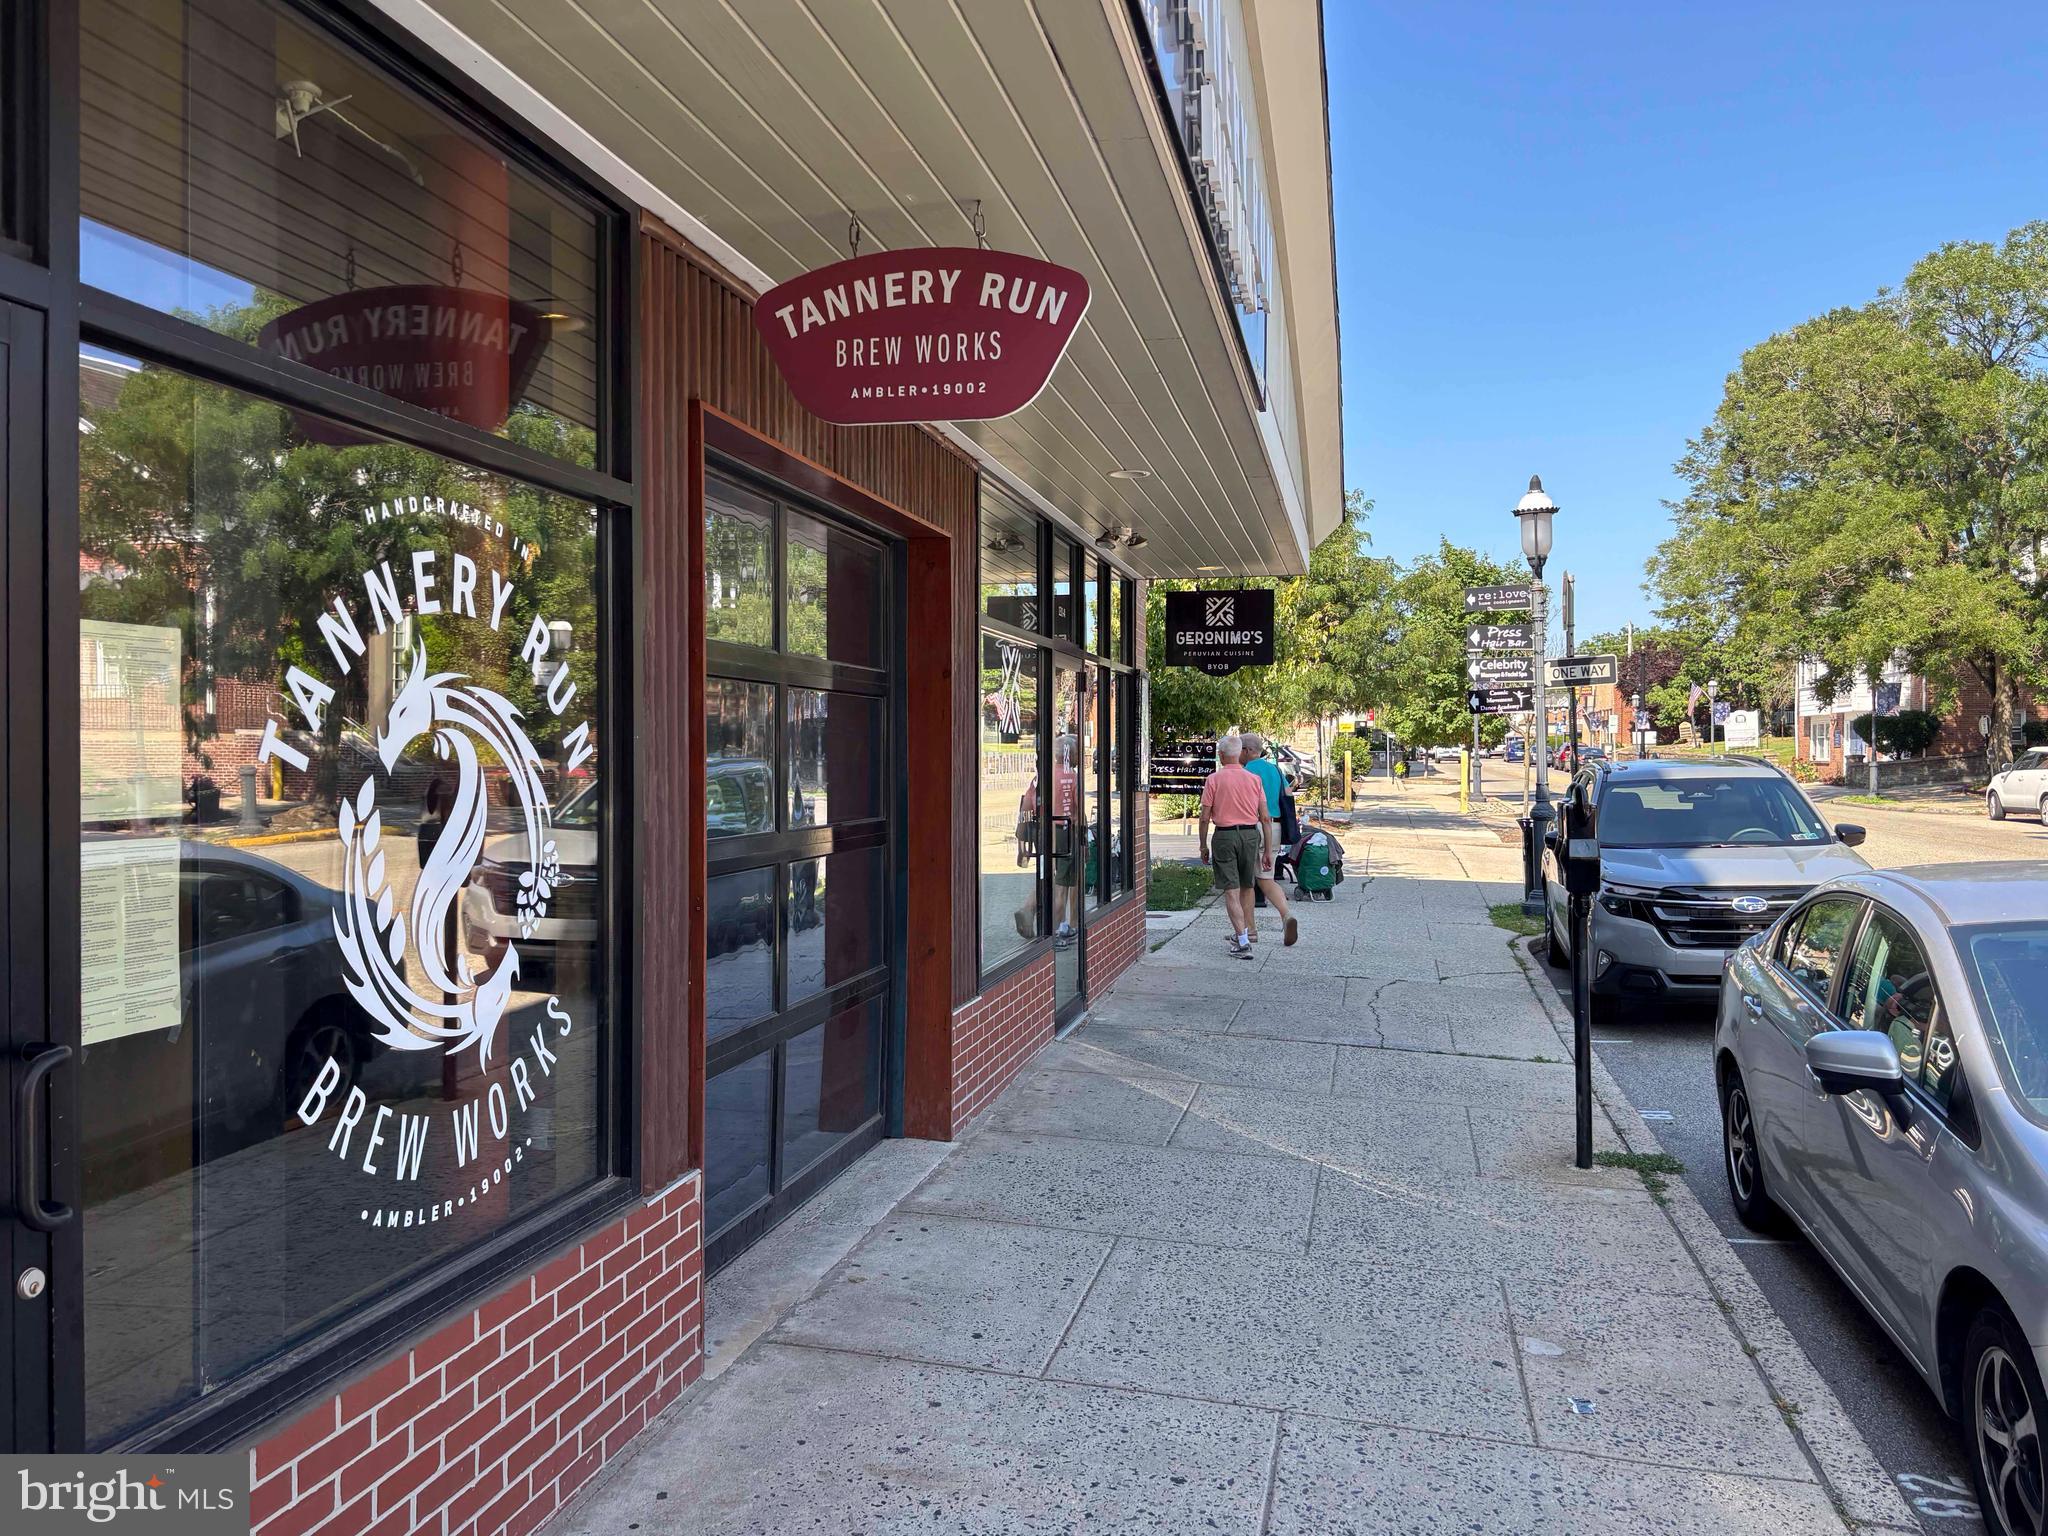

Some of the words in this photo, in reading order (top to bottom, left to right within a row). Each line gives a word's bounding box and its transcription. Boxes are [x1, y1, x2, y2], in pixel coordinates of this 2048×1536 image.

[775, 269, 962, 339] TANNERY
[979, 272, 1068, 325] RUN
[836, 336, 901, 367] BREW
[915, 331, 1001, 364] WORKS
[365, 496, 503, 538] HANDCRAFTED
[513, 537, 529, 560] IN
[1478, 590, 1528, 600] re:love
[1176, 631, 1263, 645] GERONIMO'S
[1487, 626, 1521, 638] Press
[1481, 638, 1506, 647] Hair
[258, 550, 514, 772] TANNERY
[521, 614, 594, 772] RUN
[1480, 659, 1528, 671] Celebrity
[1553, 667, 1576, 679] ONE
[1581, 665, 1606, 677] WAY
[1177, 765, 1196, 773] Hair
[297, 1056, 430, 1181] BREW
[452, 996, 572, 1168] WORKS
